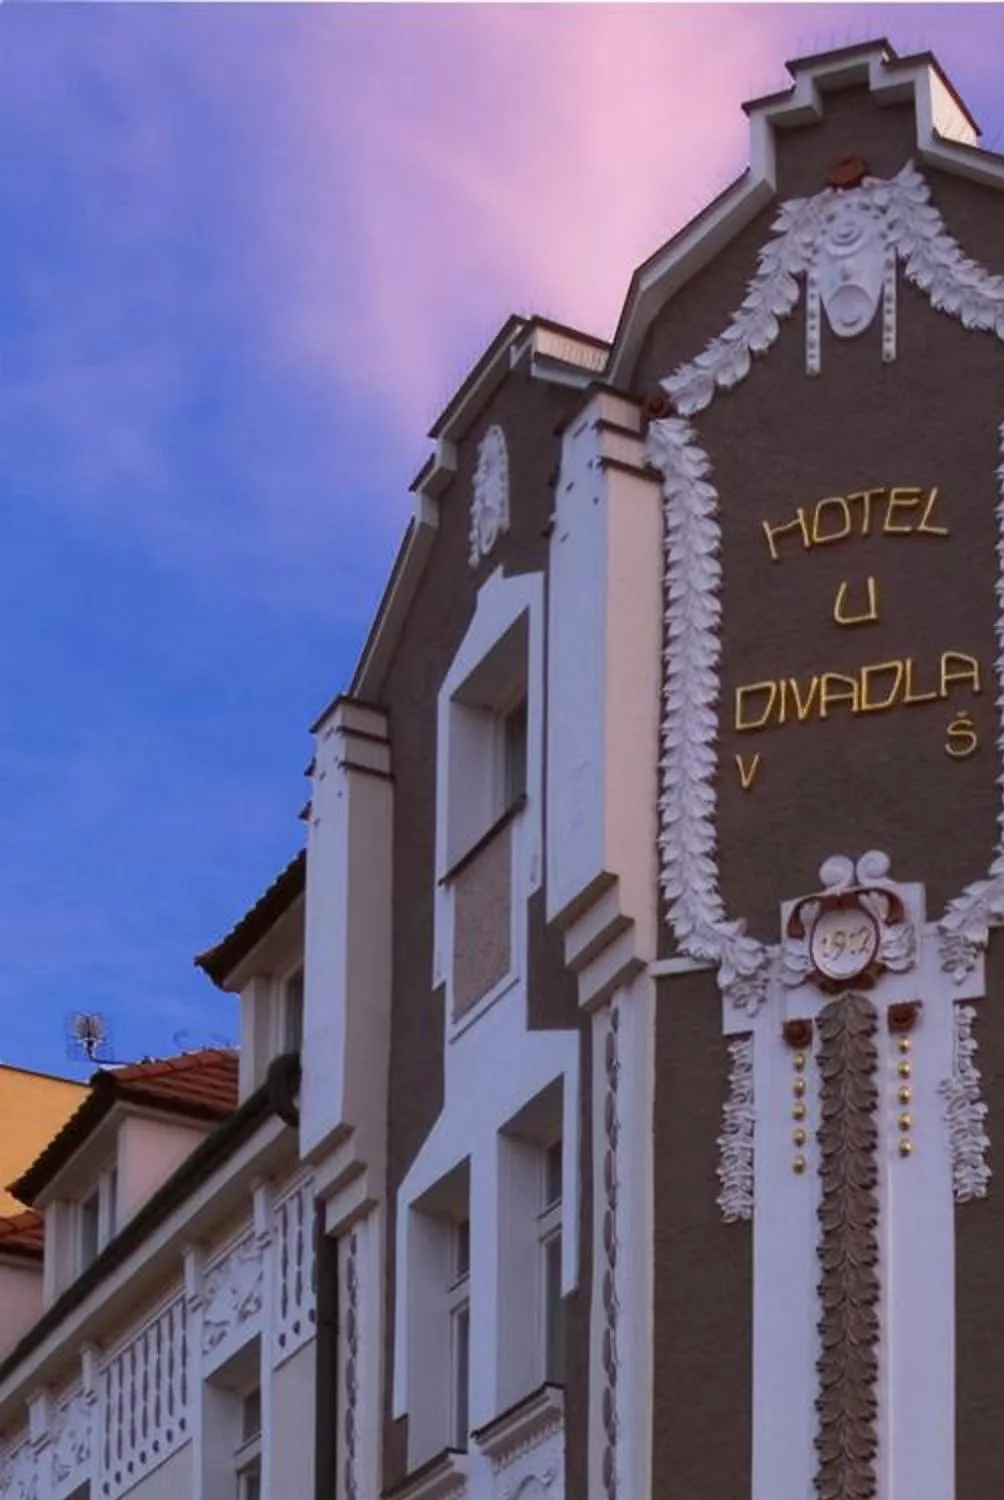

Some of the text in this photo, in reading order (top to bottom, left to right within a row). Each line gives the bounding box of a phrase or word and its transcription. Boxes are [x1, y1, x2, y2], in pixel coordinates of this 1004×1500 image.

[763, 486, 951, 561] HOTEL
[834, 576, 880, 625] U
[735, 650, 982, 731] DIVADLA
[735, 710, 978, 790] V Š
